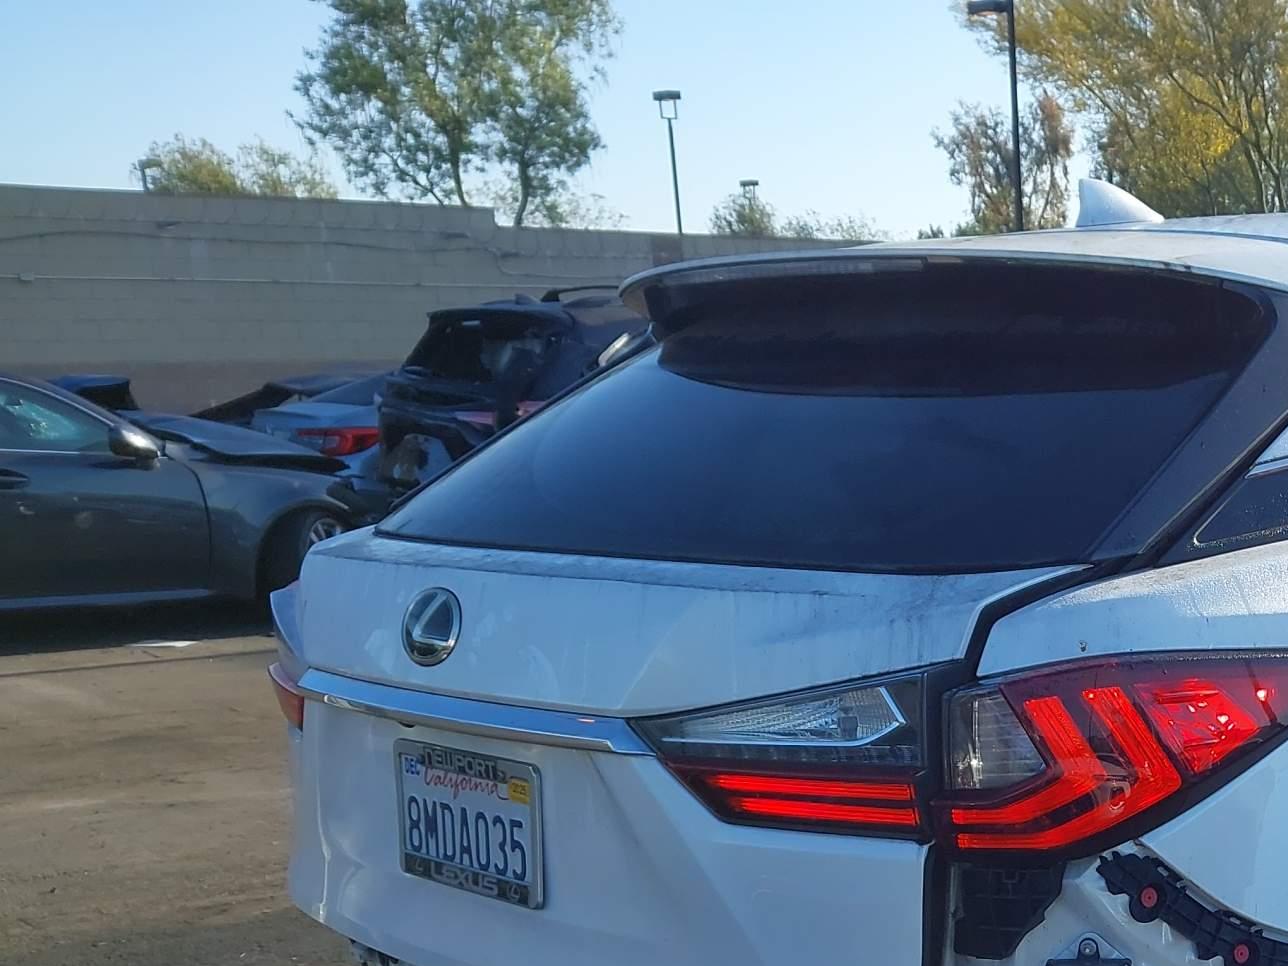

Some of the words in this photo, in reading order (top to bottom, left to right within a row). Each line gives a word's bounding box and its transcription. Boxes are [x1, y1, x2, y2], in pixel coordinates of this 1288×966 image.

[424, 767, 510, 799] California
[407, 795, 527, 882] 8MDA035
[430, 862, 498, 895] LEXUS
